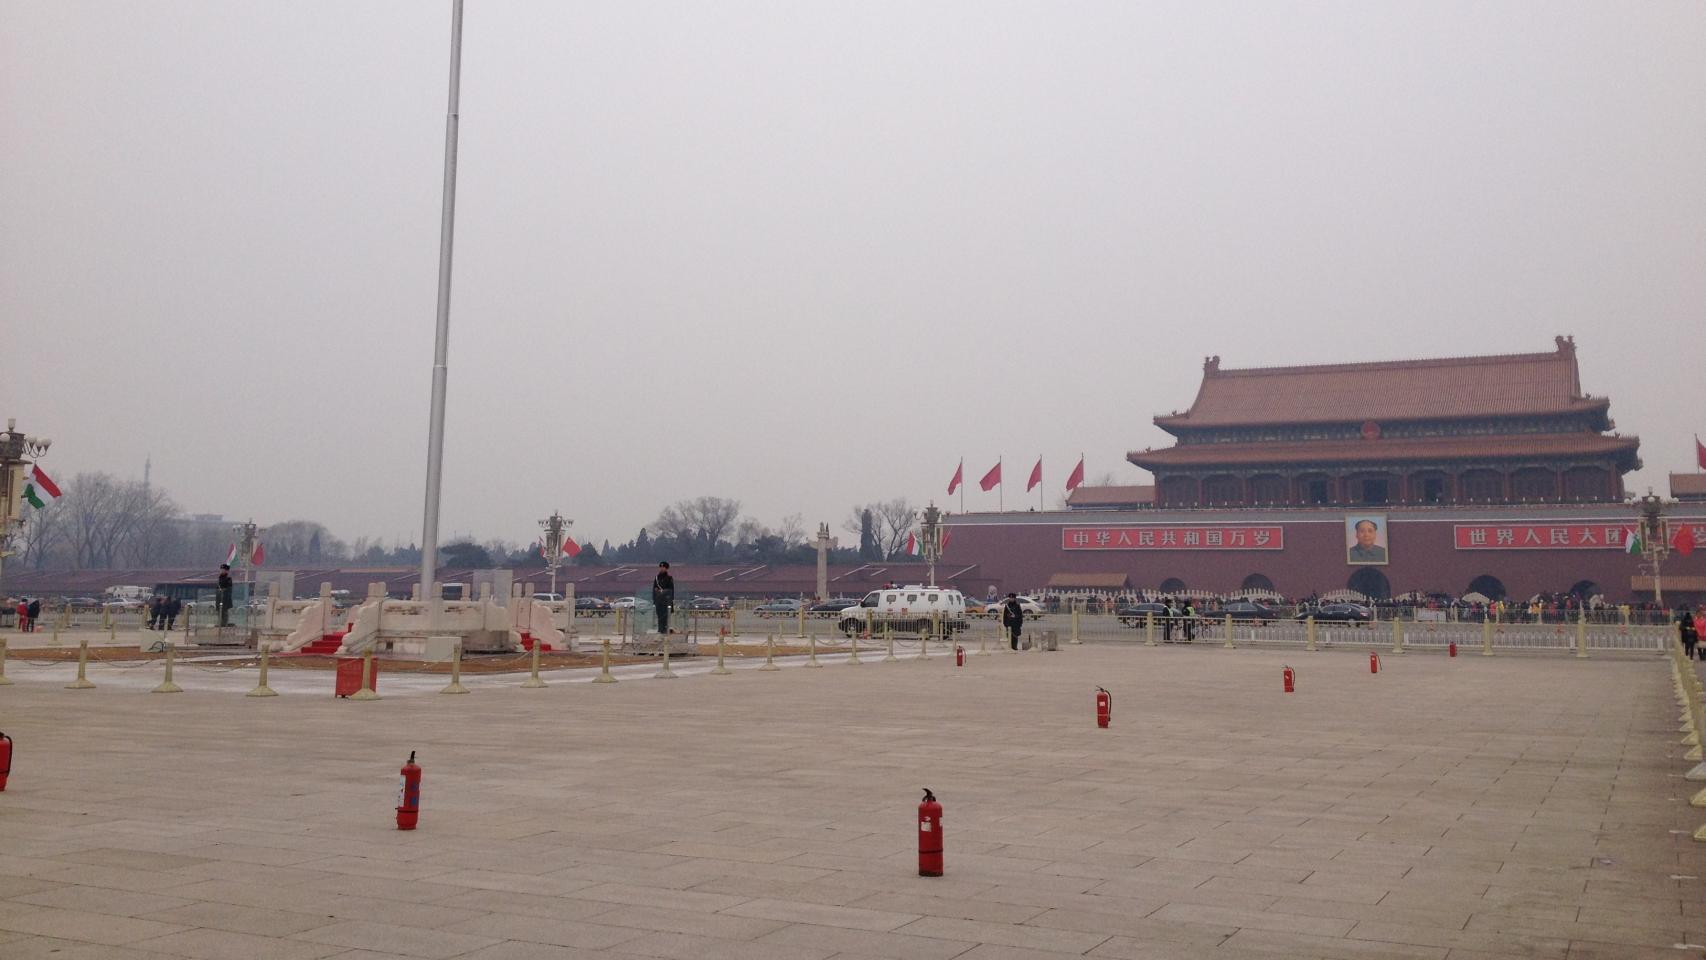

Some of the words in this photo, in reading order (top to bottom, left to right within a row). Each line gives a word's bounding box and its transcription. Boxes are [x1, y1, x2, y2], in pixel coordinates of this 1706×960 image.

[1072, 530, 1271, 546] 中华人民共和国万岁
